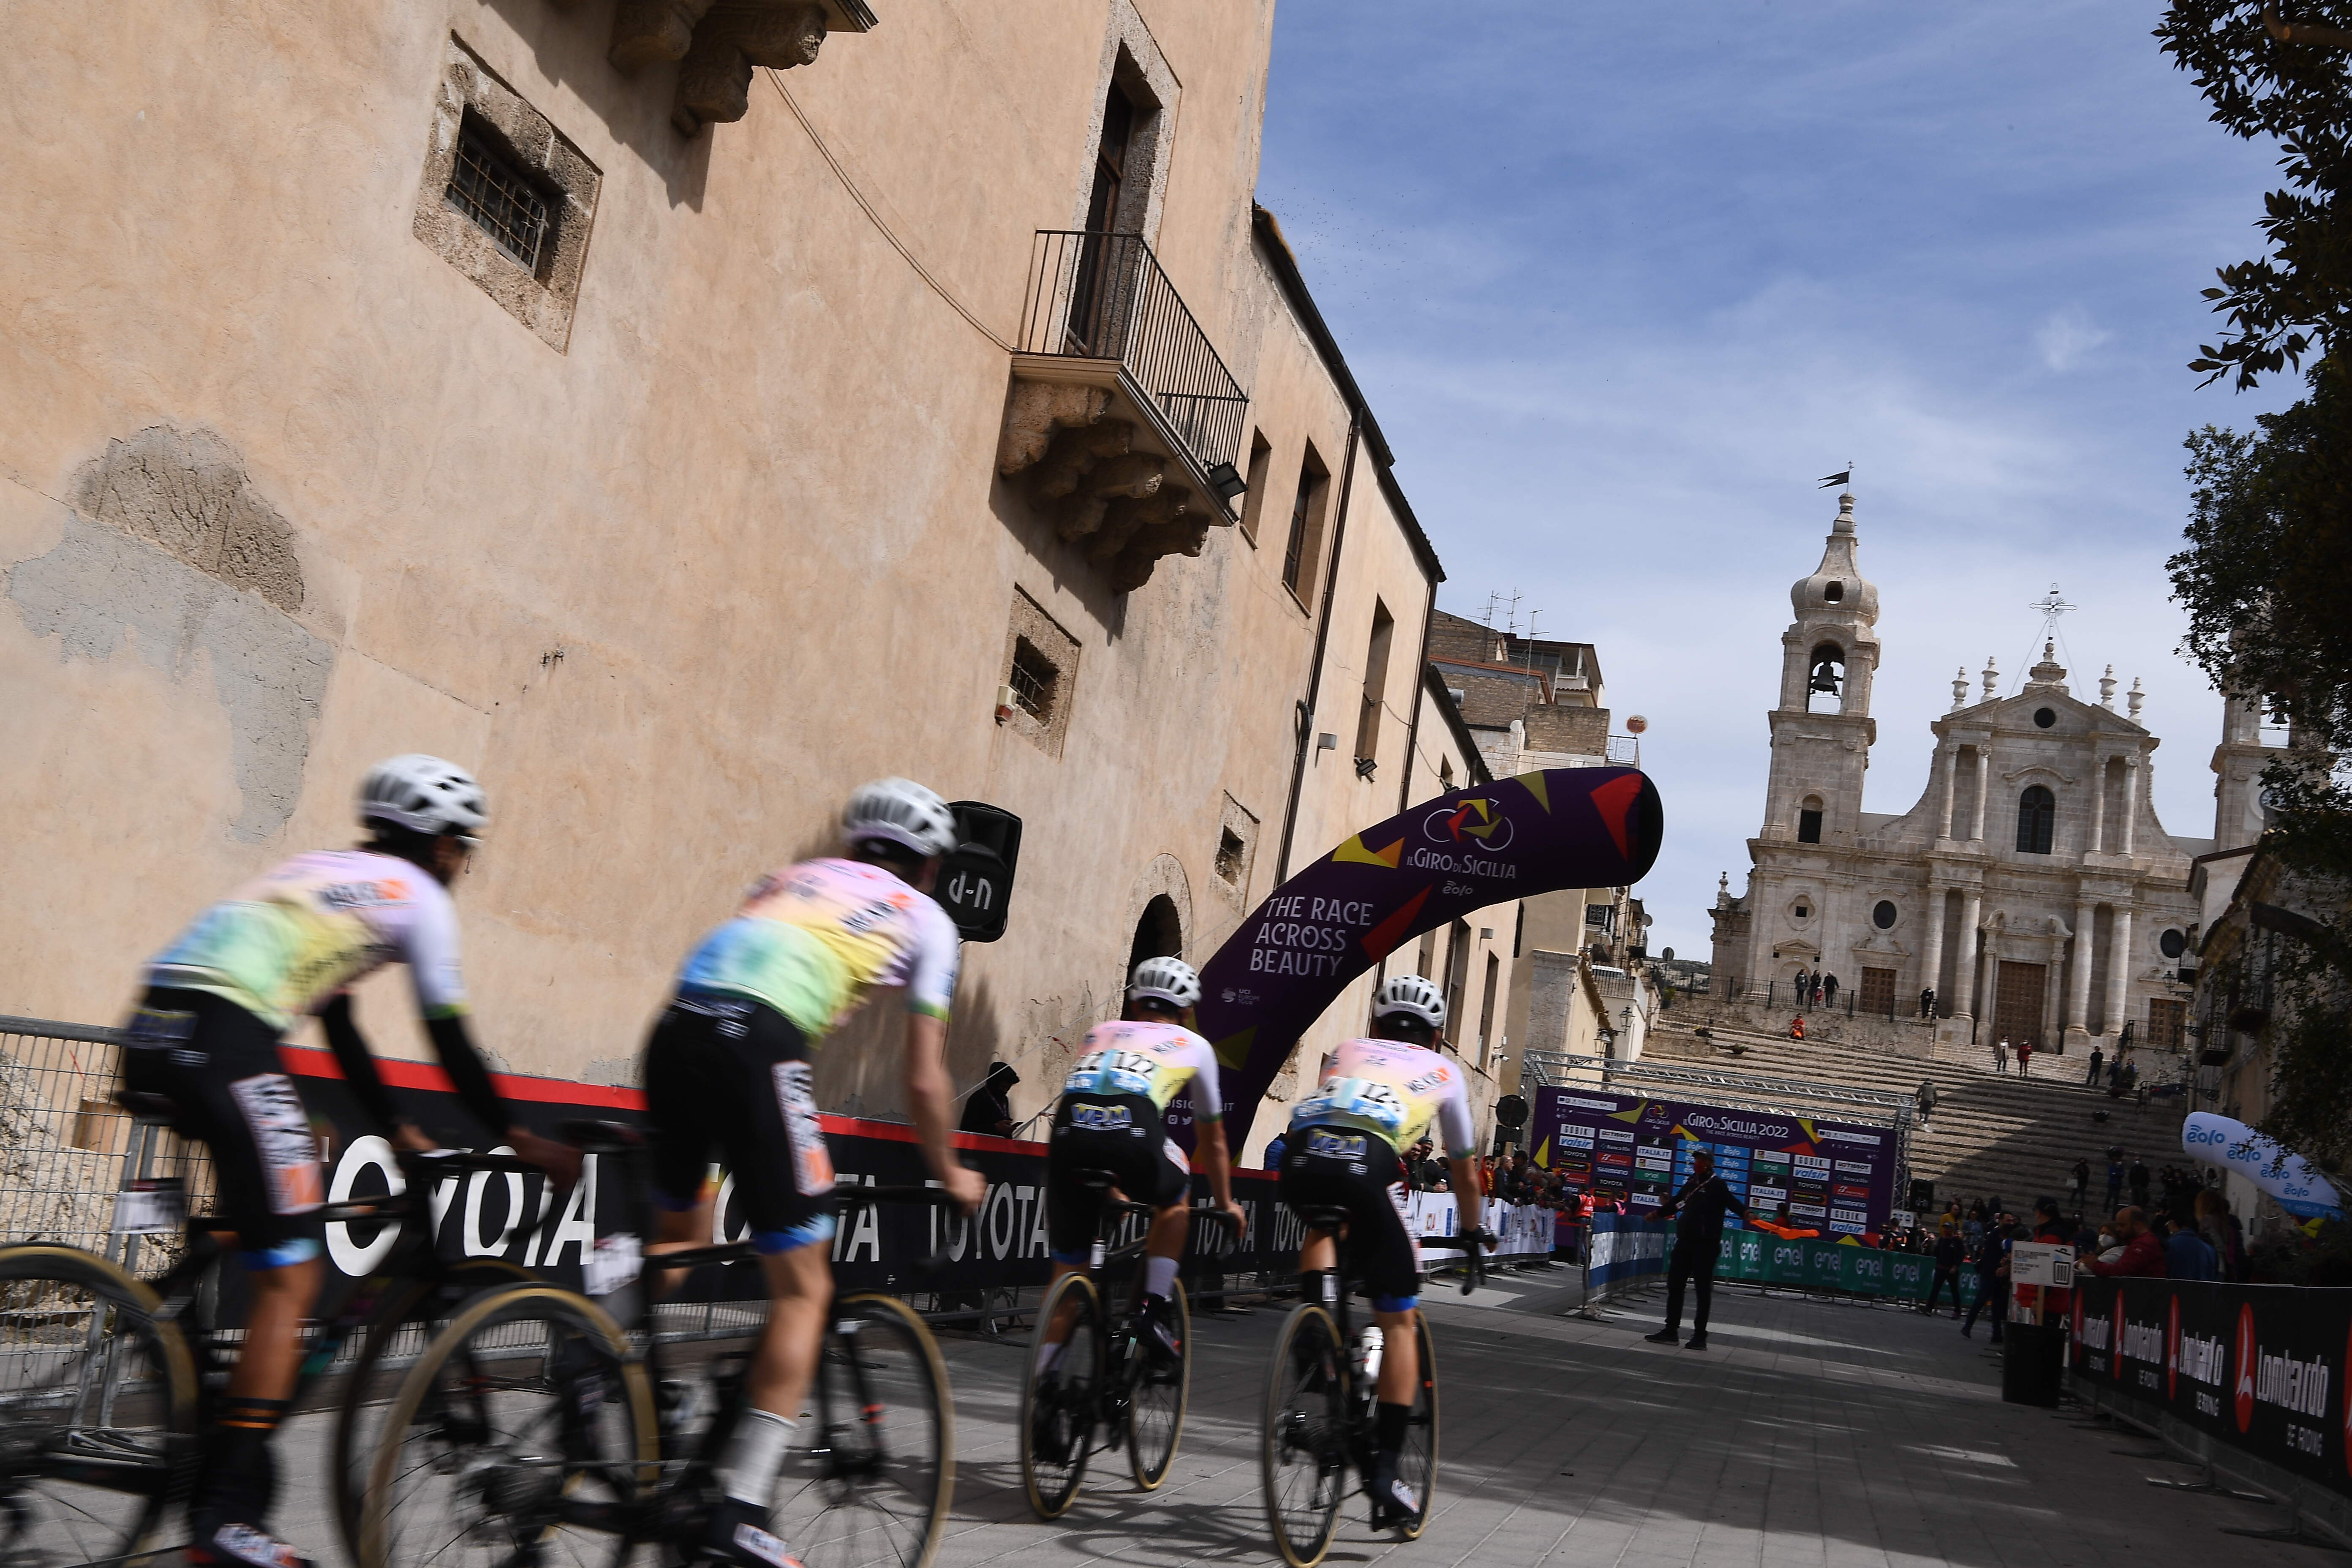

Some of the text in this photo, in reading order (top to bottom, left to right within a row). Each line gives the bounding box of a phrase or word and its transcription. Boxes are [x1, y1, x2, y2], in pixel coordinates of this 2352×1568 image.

[1414, 848, 1453, 871] GIRO
[1462, 855, 1516, 879] SICILIA
[1266, 896, 1373, 926] THE RACE
[1255, 922, 1346, 951] ACROSS
[1250, 948, 1344, 977] BEAUTY
[1688, 1113, 1714, 1128] GIRO
[1720, 1116, 1757, 1134] SICILIA
[1758, 1124, 1789, 1138] 2022
[1561, 1138, 1591, 1148] valsir
[2187, 1130, 2224, 1145] eolo
[1563, 1150, 1587, 1158] TOYOTA
[1639, 1148, 1670, 1157] ITALIA.IT
[2227, 1149, 2261, 1162] eolo
[1596, 1167, 1628, 1176] SHIMANO
[1795, 1169, 1827, 1179] valsir
[2261, 1168, 2290, 1180] eolo
[1753, 1187, 1784, 1196] ITALIA.IT
[1798, 1181, 1822, 1190] TOYOTA
[2284, 1187, 2309, 1197] eolo
[320, 1136, 596, 1277] OYOTA
[1833, 1199, 1866, 1208] SHIMANO
[924, 1181, 1051, 1262] TOYOTA
[1831, 1223, 1863, 1233] valsir
[1740, 1239, 1762, 1261] enel
[1775, 1244, 1804, 1266] enel
[1815, 1250, 1842, 1271] enel
[1856, 1256, 1883, 1277] enel
[1892, 1262, 1920, 1282] enel
[2256, 1344, 2329, 1418] Lombardo
